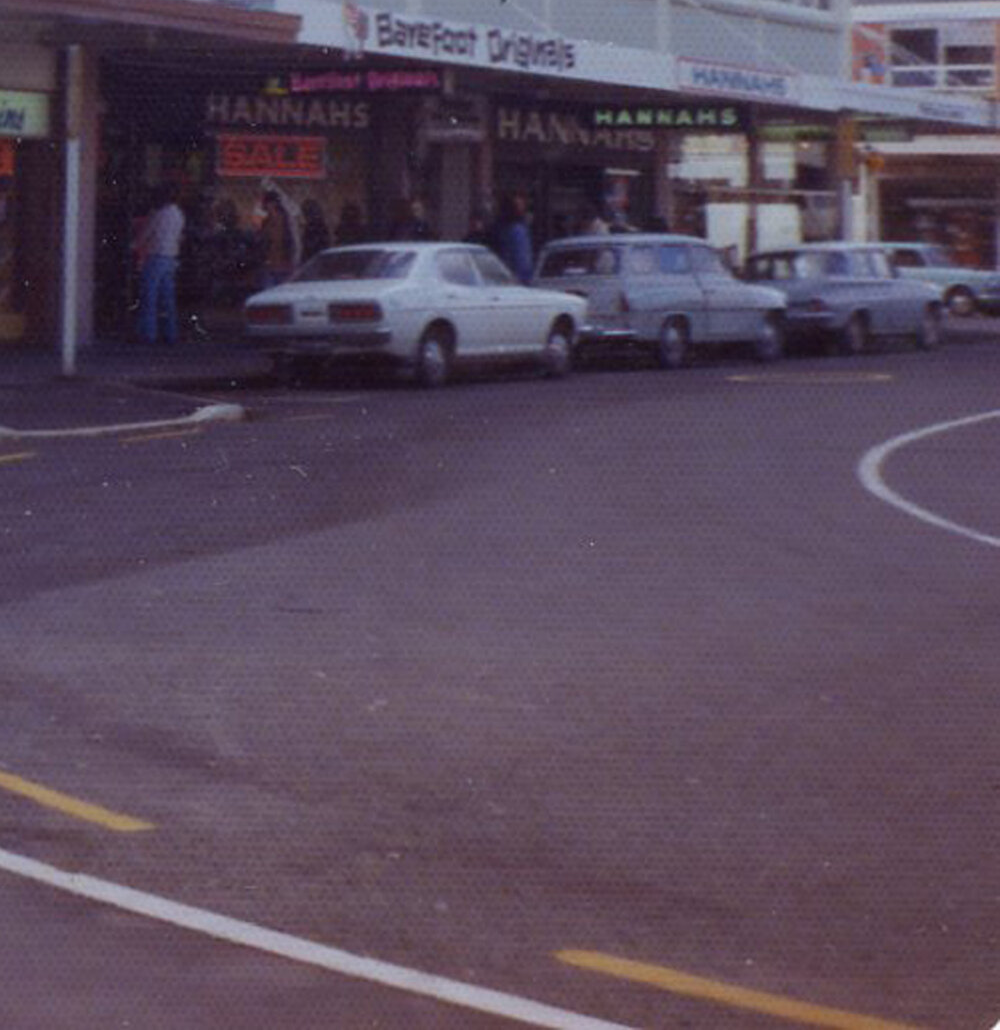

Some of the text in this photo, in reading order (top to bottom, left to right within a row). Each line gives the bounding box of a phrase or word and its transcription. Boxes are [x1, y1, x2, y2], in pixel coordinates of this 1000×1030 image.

[204, 93, 371, 128] HANNAHS
[595, 108, 738, 127] HANNAHS
[223, 141, 322, 171] SALE
